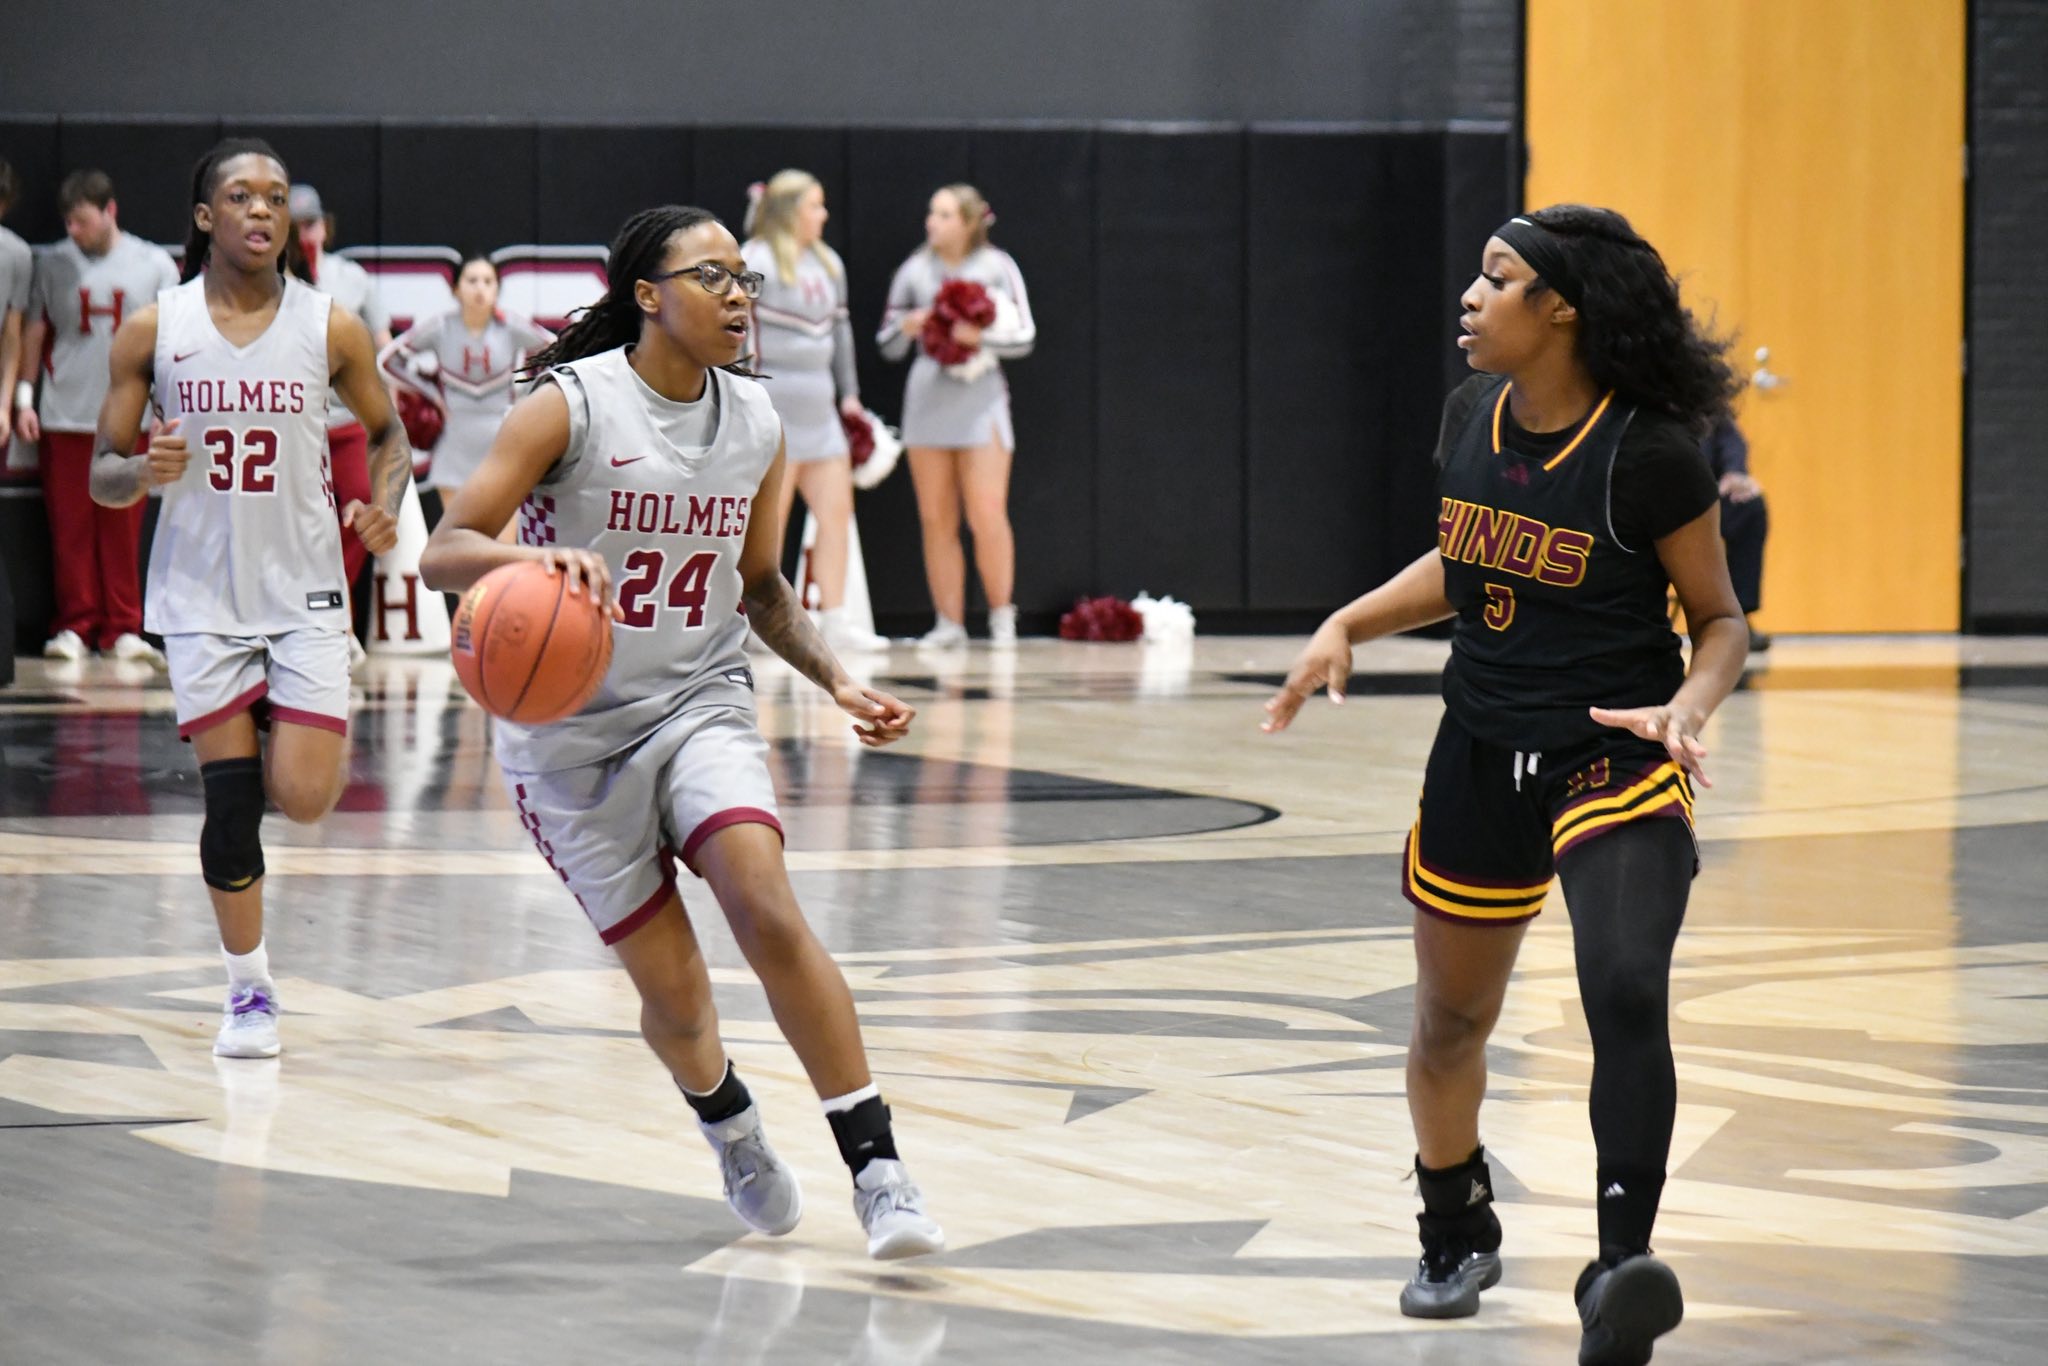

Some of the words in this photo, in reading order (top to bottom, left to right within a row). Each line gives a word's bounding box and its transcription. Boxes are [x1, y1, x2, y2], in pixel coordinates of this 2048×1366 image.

[79, 288, 124, 335] H
[463, 346, 492, 375] H
[177, 380, 304, 413] HOLMES
[204, 427, 280, 496] 32
[607, 490, 748, 537] HOLMES
[1439, 497, 1595, 588] HINDS
[375, 574, 422, 641] H
[614, 549, 721, 632] 24
